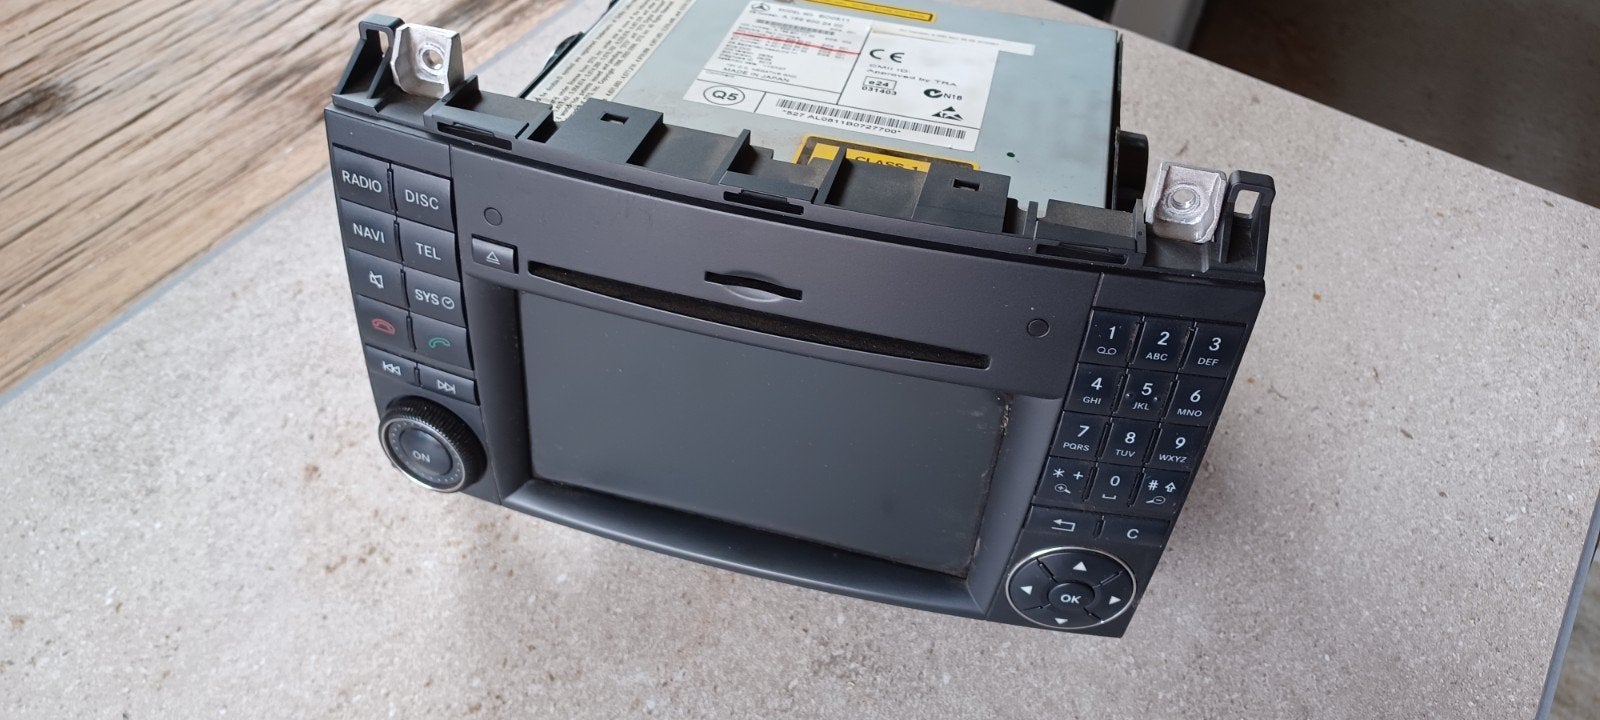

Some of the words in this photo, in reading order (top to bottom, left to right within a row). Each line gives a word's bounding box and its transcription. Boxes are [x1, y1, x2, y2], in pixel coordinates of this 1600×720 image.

[869, 49, 905, 63] CE
[723, 67, 748, 75] MADE
[867, 69, 916, 80] Approved
[712, 90, 738, 101] Q5
[342, 170, 382, 193] RADIO
[405, 189, 439, 210] DISC
[352, 222, 385, 243] NAVI
[415, 242, 441, 261] TEL
[415, 289, 440, 306] SYS
[1109, 326, 1116, 340] 1
[1157, 331, 1170, 346] 2
[1208, 337, 1222, 351] 3
[1145, 352, 1168, 361] ABC
[1197, 357, 1219, 366] DEF
[1091, 377, 1103, 391] 4
[1141, 382, 1153, 396] 5
[1082, 396, 1101, 405] GHI
[1189, 389, 1201, 403] 6
[1132, 402, 1150, 411] JKL
[1176, 408, 1202, 417] MNO
[1077, 425, 1089, 437] 7
[1124, 431, 1136, 444] 8
[1175, 437, 1186, 449] 9
[1062, 441, 1090, 451] PQRS
[412, 451, 431, 463] ON
[1115, 449, 1136, 458] TUV
[1158, 453, 1187, 463] WXYZ
[1110, 475, 1121, 487] 0
[1126, 528, 1139, 539] C
[1060, 593, 1082, 604] OK
